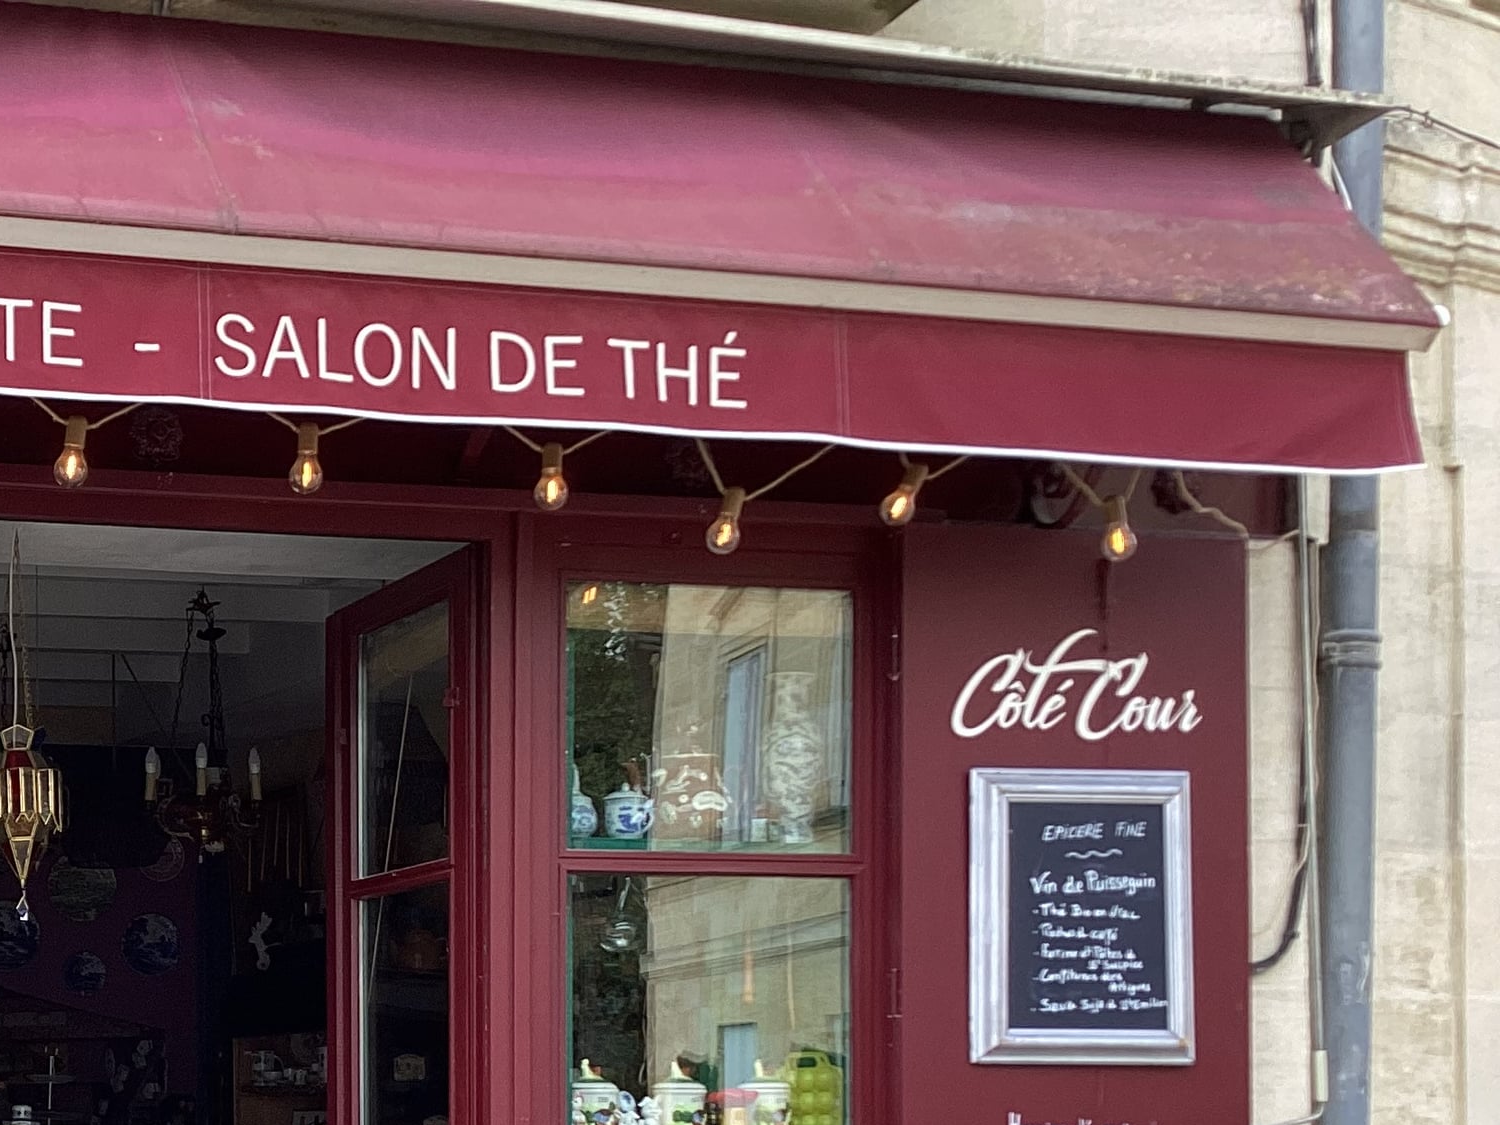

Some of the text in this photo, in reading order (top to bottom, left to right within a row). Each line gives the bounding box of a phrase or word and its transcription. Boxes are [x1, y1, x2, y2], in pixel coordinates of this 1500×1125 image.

[214, 314, 455, 389] SALON
[490, 332, 584, 395] DE
[608, 332, 746, 408] THÉ
[950, 628, 1203, 740] Côté Cour
[1029, 871, 1058, 894] Vin
[1062, 875, 1084, 894] de
